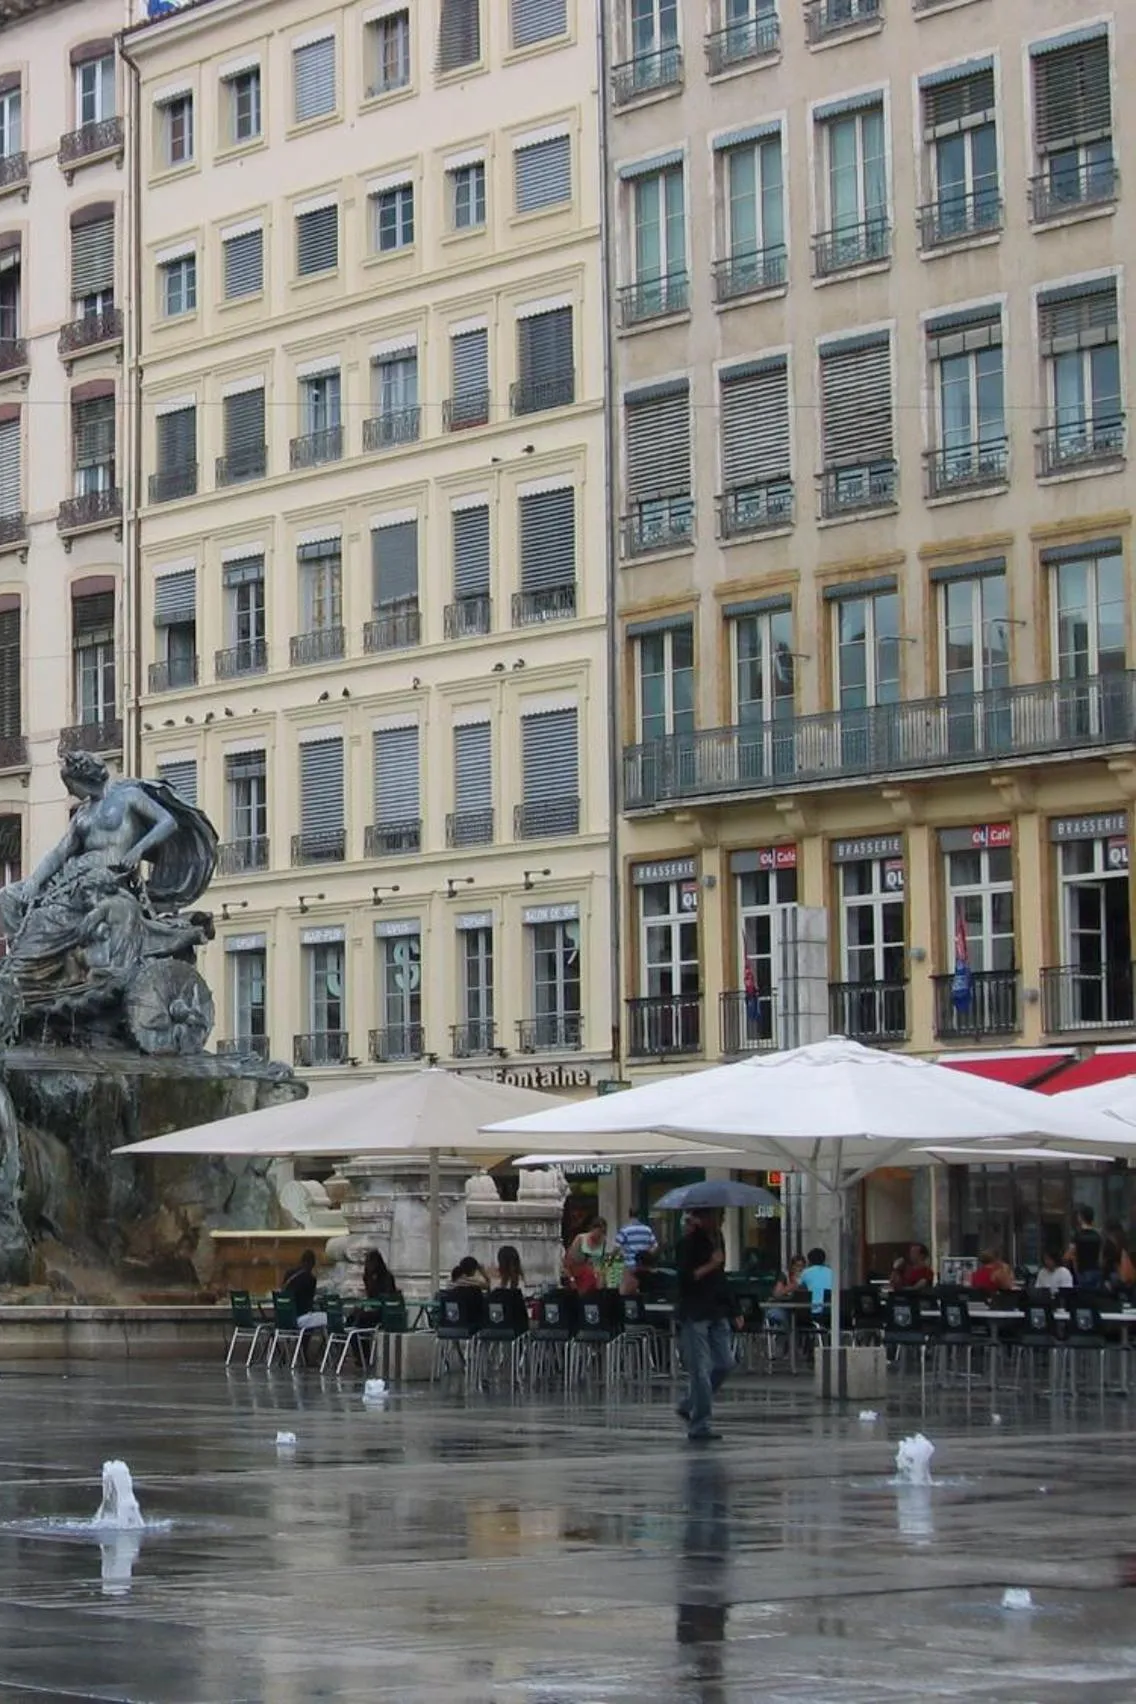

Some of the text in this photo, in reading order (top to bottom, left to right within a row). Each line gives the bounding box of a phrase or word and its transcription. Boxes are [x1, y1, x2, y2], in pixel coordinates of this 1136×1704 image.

[1058, 816, 1125, 835] BRASSERIE
[838, 838, 900, 857] BRASSERIE
[639, 861, 695, 879] BRASSERIE
[493, 1066, 590, 1088] Fontaine
